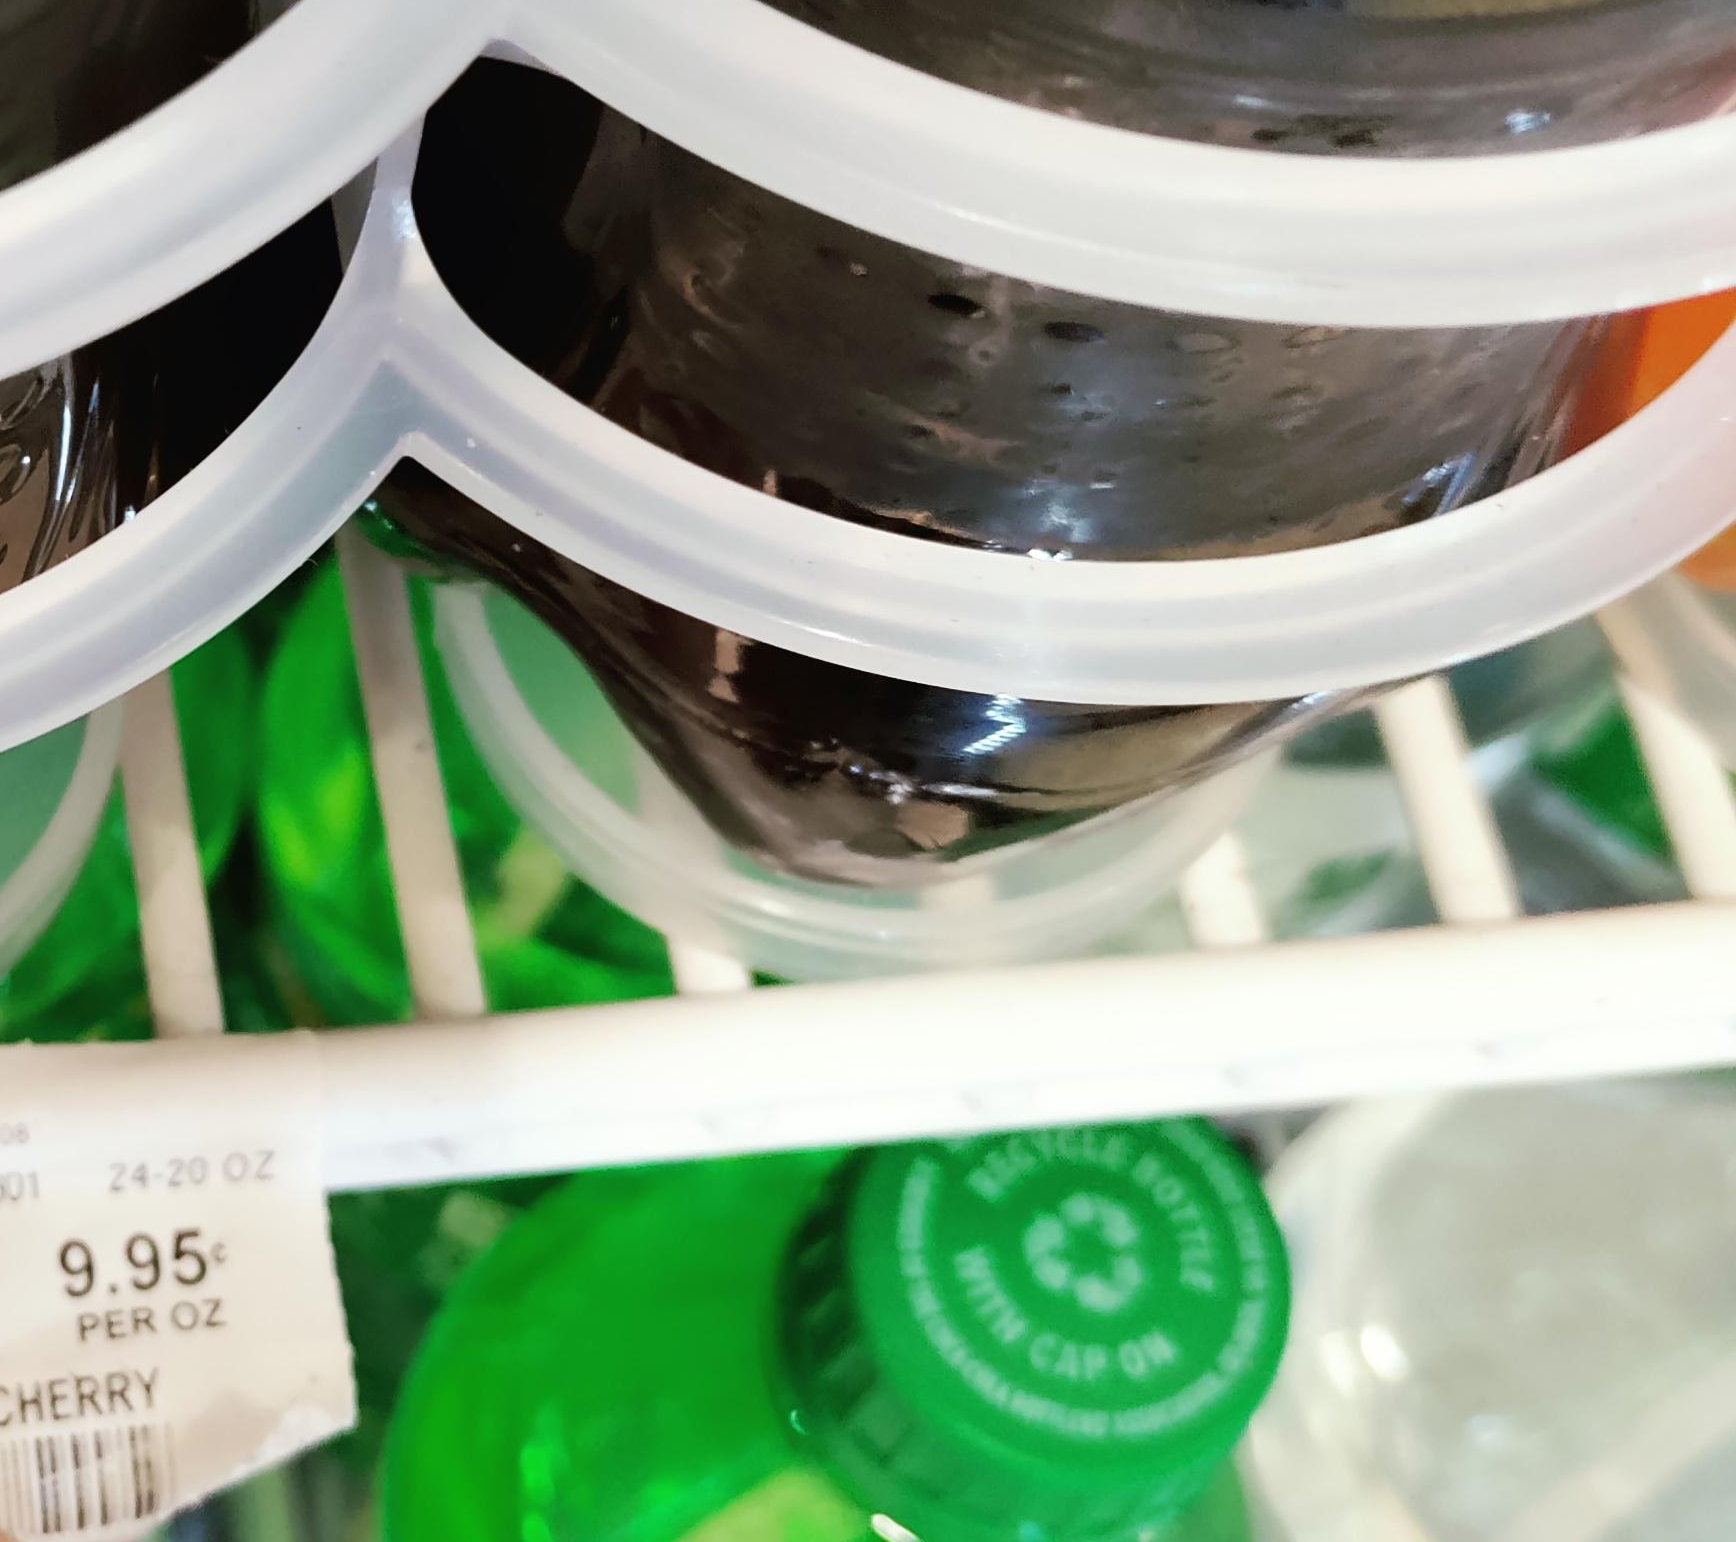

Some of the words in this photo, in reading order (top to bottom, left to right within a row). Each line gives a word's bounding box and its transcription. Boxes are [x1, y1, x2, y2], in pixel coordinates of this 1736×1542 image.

[108, 1159, 210, 1194] 24-20
[221, 1148, 278, 1183] OZ
[77, 1306, 159, 1343] PER
[170, 1297, 227, 1332] OZ
[1029, 1331, 1110, 1381] CAP
[1117, 1327, 1180, 1381] ON
